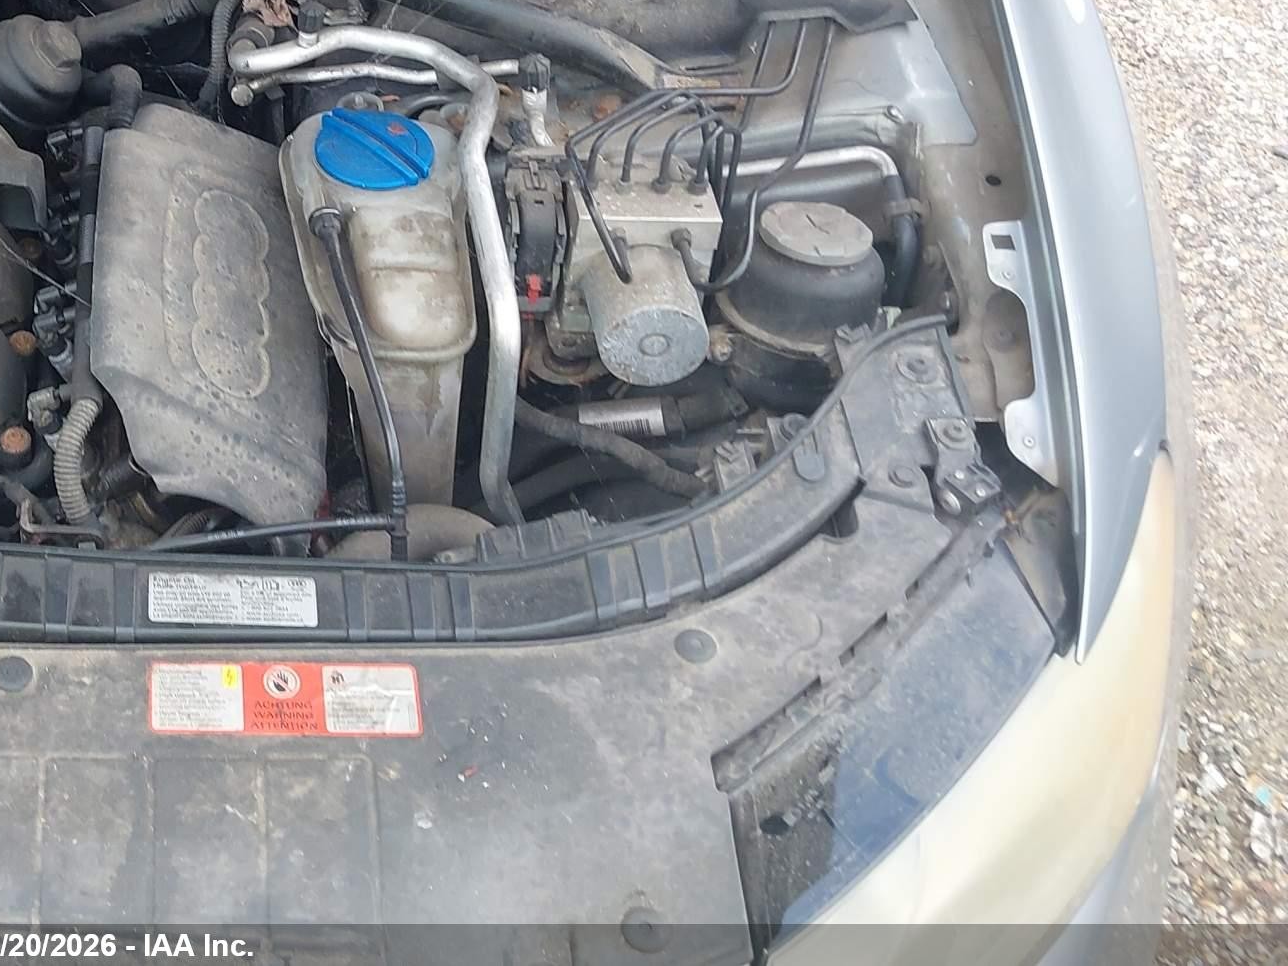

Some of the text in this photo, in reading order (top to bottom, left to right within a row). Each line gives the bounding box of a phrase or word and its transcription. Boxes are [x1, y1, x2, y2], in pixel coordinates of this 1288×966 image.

[255, 699, 313, 710] ACHTUNG
[253, 710, 314, 720] WARNING
[251, 720, 319, 731] ATTENTION
